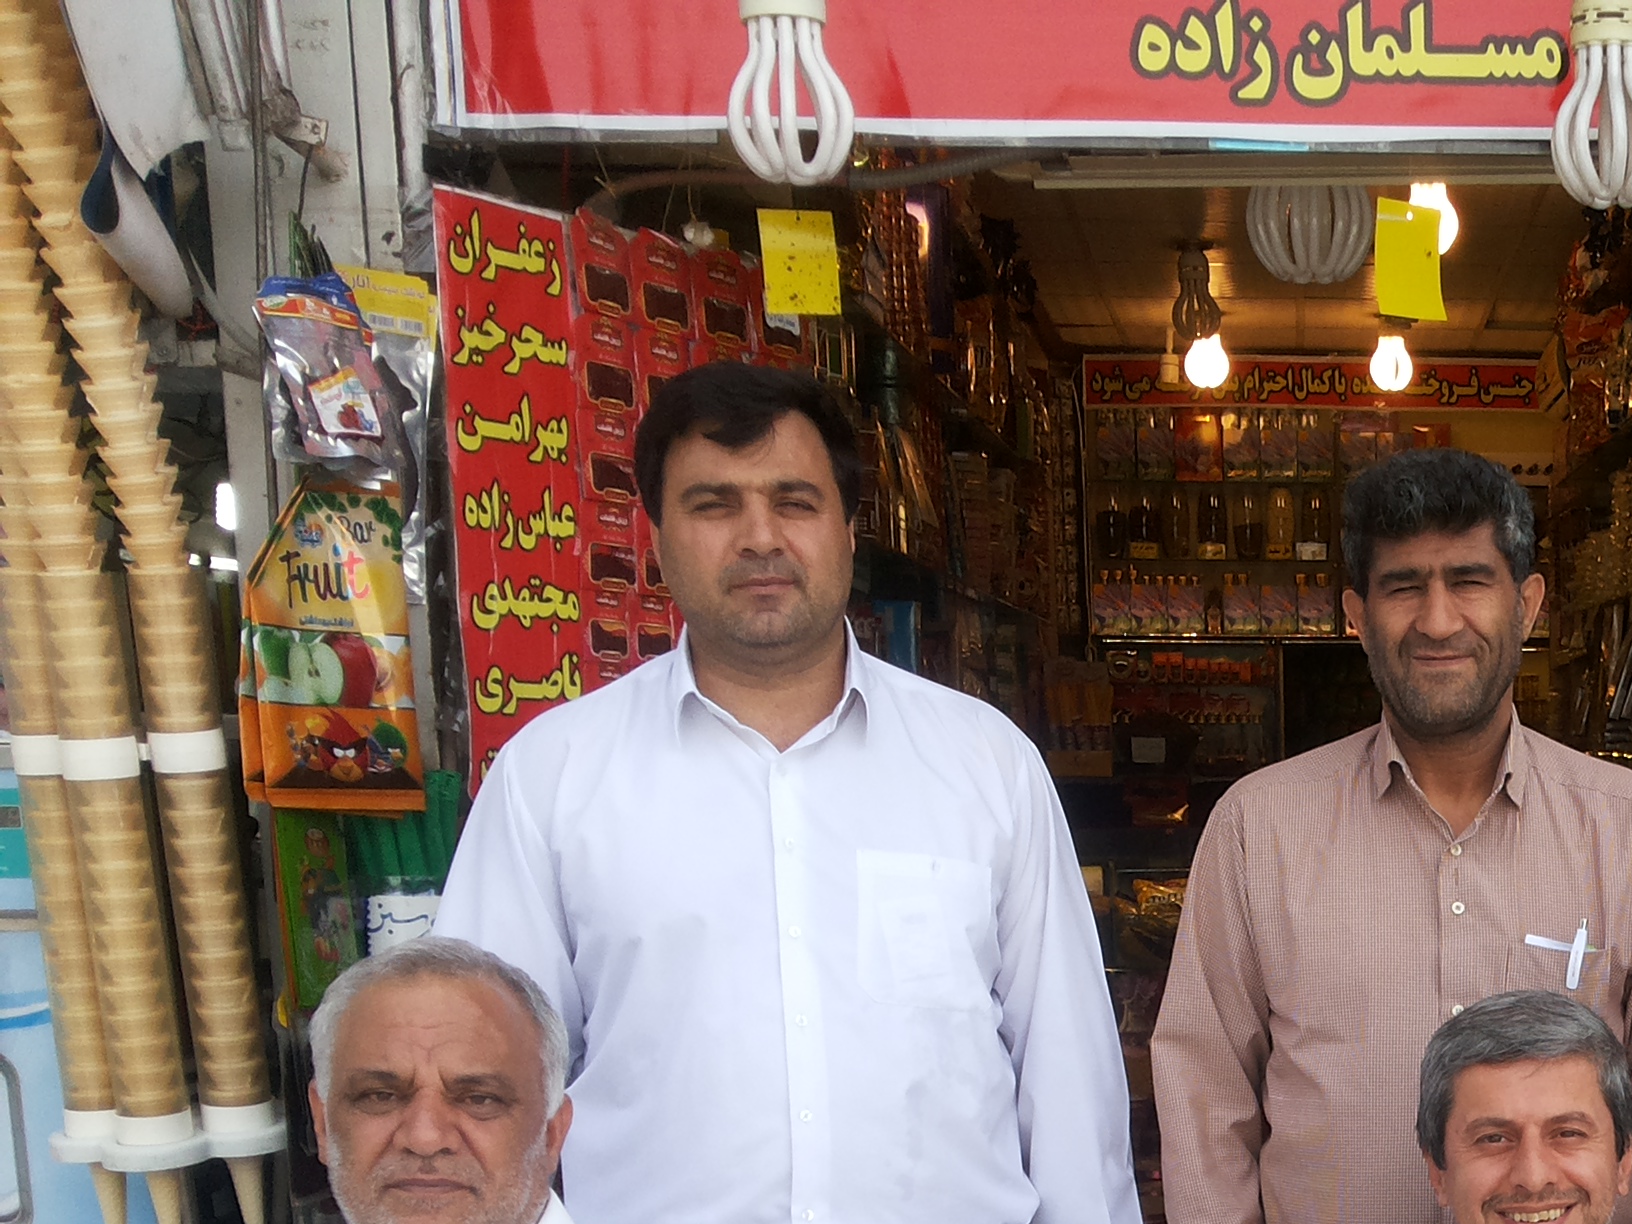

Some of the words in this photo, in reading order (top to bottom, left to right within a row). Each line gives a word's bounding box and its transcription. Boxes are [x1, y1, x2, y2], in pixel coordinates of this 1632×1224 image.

[1131, 0, 1280, 104] زاده
[1288, 0, 1567, 104] مسلمان
[449, 207, 562, 297] زعفران
[1092, 366, 1123, 400] شود
[1125, 374, 1151, 400] می
[1243, 366, 1293, 401] احترام
[1292, 367, 1333, 401] کمال
[1334, 368, 1347, 400] با
[1480, 374, 1534, 404] جنس
[456, 393, 569, 464] بهرامن
[278, 549, 370, 609] Fruit
[471, 575, 580, 633] مجتهدی
[475, 652, 582, 716] ناصری
